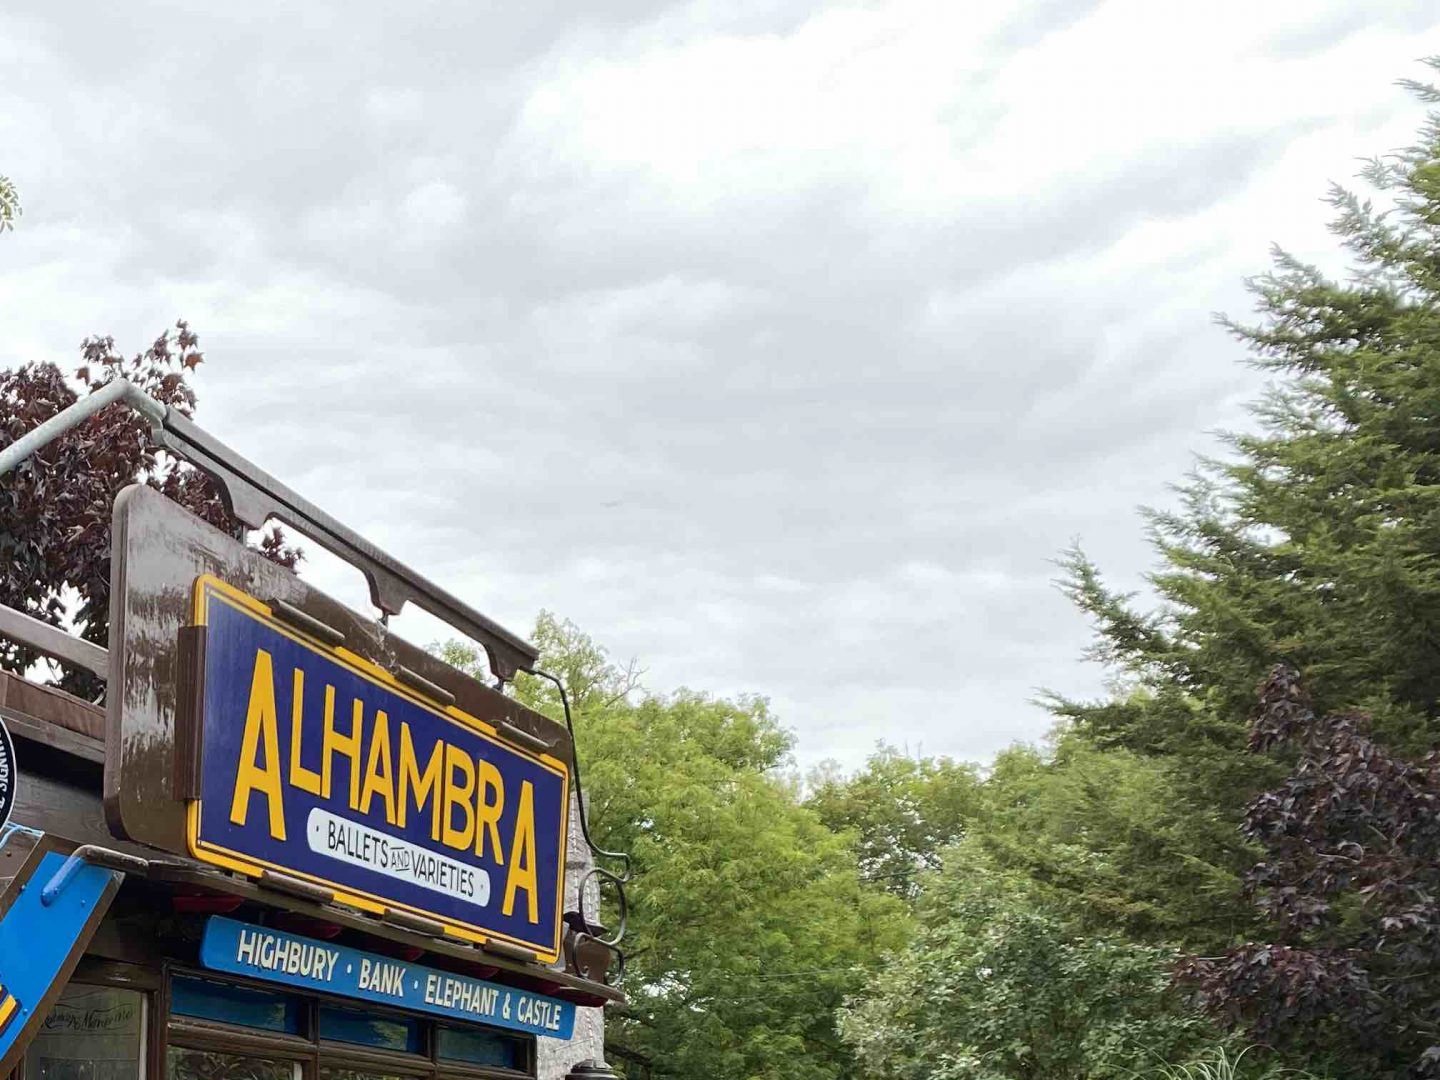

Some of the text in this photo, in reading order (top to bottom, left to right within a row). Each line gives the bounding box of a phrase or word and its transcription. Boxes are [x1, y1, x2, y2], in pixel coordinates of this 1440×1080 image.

[230, 648, 539, 924] ALHAMBRA
[328, 819, 474, 898] BALLETS AND VARIETIES
[236, 929, 562, 1030] HIGHBURY BANK ELEPHANT & CASTLE
